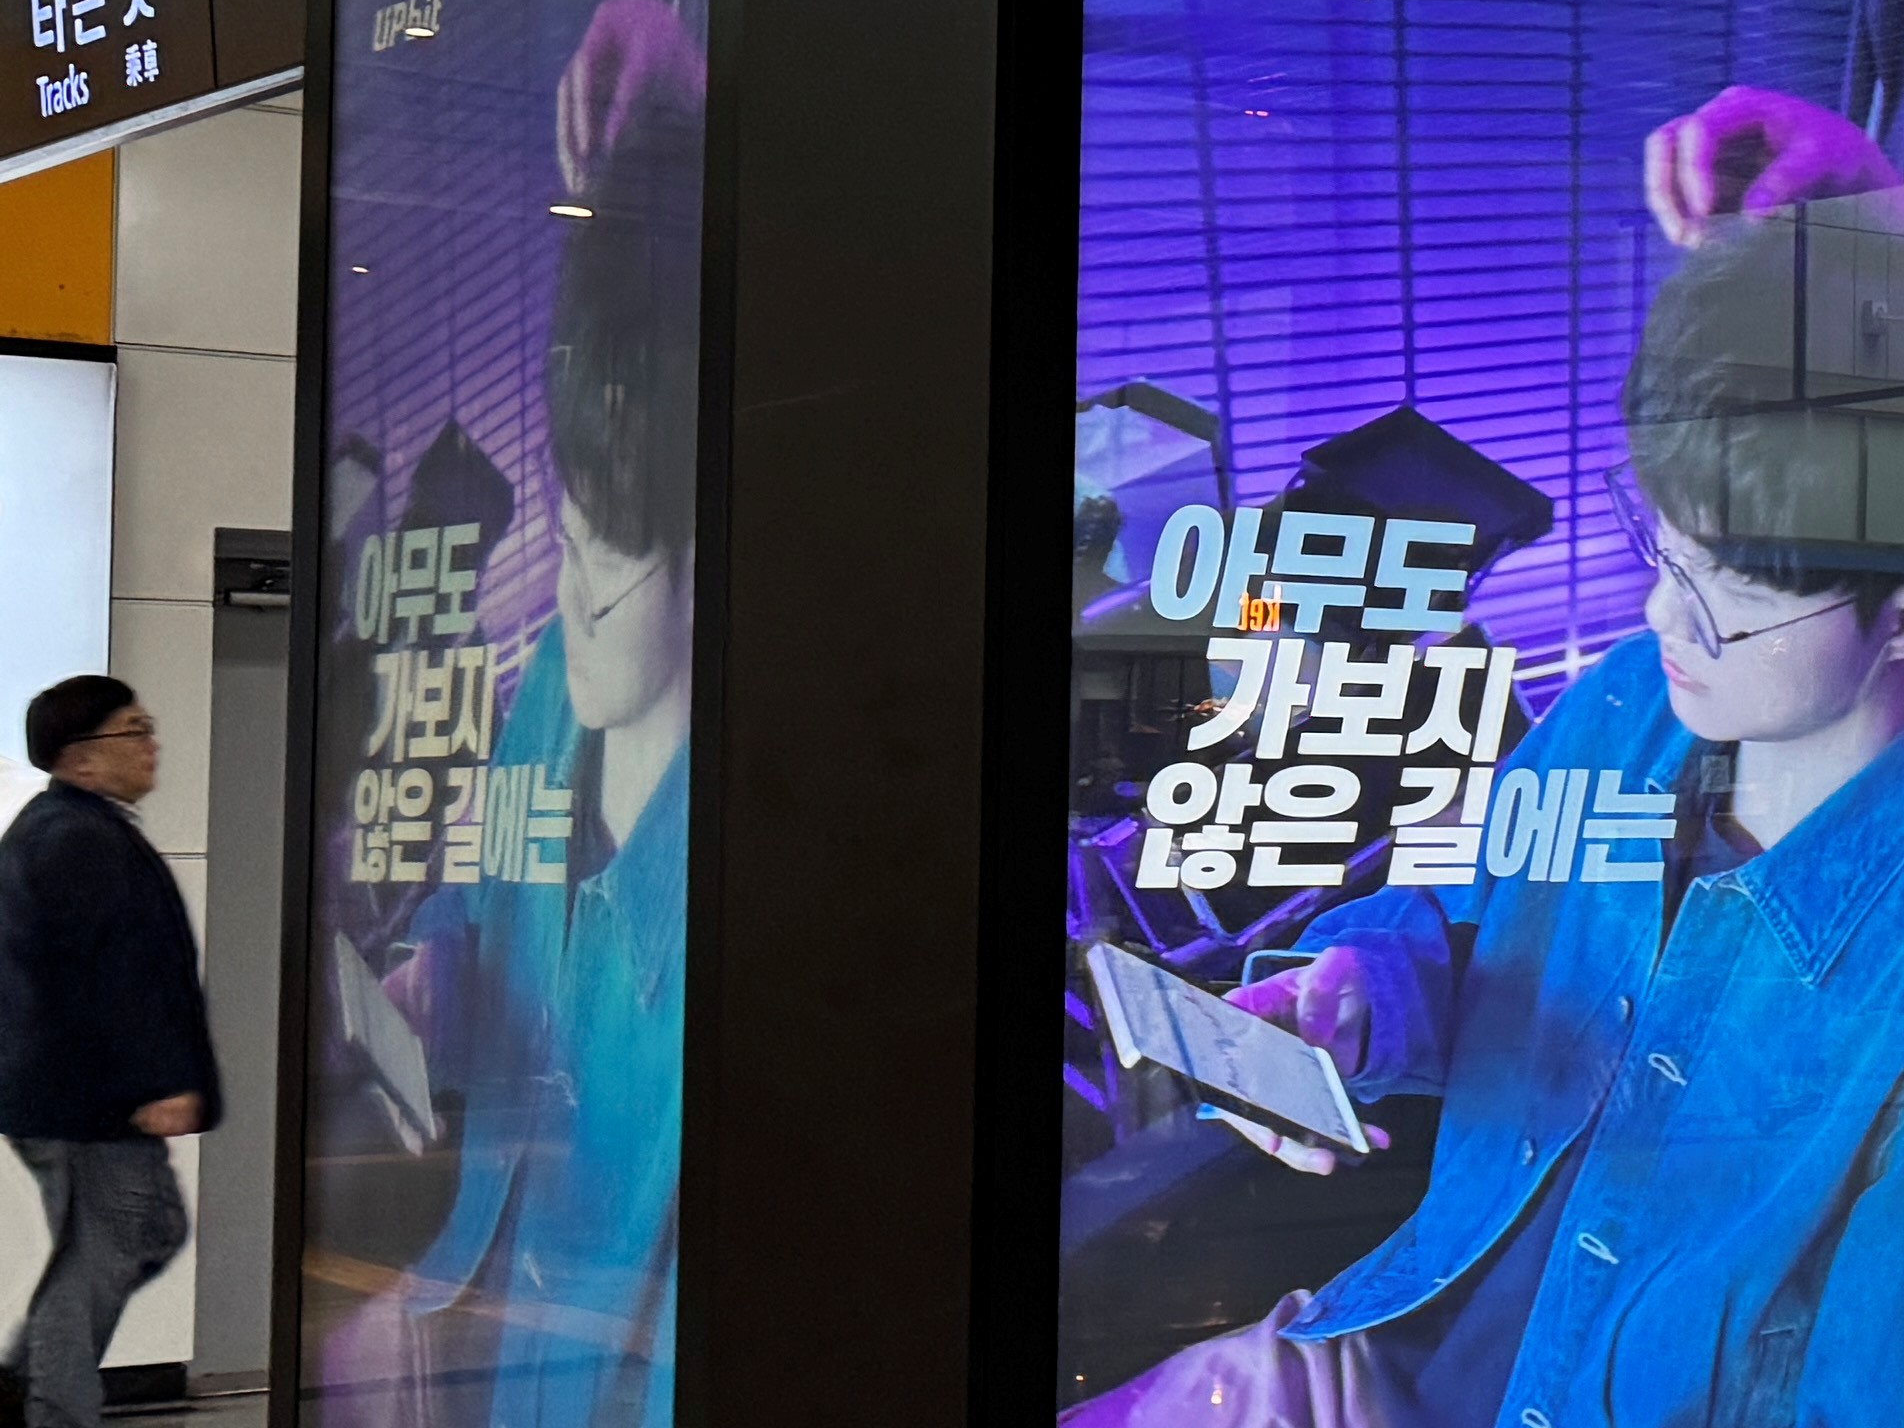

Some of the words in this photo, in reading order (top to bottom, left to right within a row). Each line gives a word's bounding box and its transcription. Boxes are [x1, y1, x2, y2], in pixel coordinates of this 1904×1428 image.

[36, 63, 89, 117] Tracks
[353, 522, 481, 644] 아무도
[1150, 504, 1476, 633] 아무도
[366, 643, 498, 763] 가보지
[1187, 637, 1516, 762] 가보지
[350, 766, 434, 884] 않은
[442, 764, 573, 884] 길에는
[1135, 763, 1361, 889] 않은
[1386, 767, 1677, 886] 길에는
